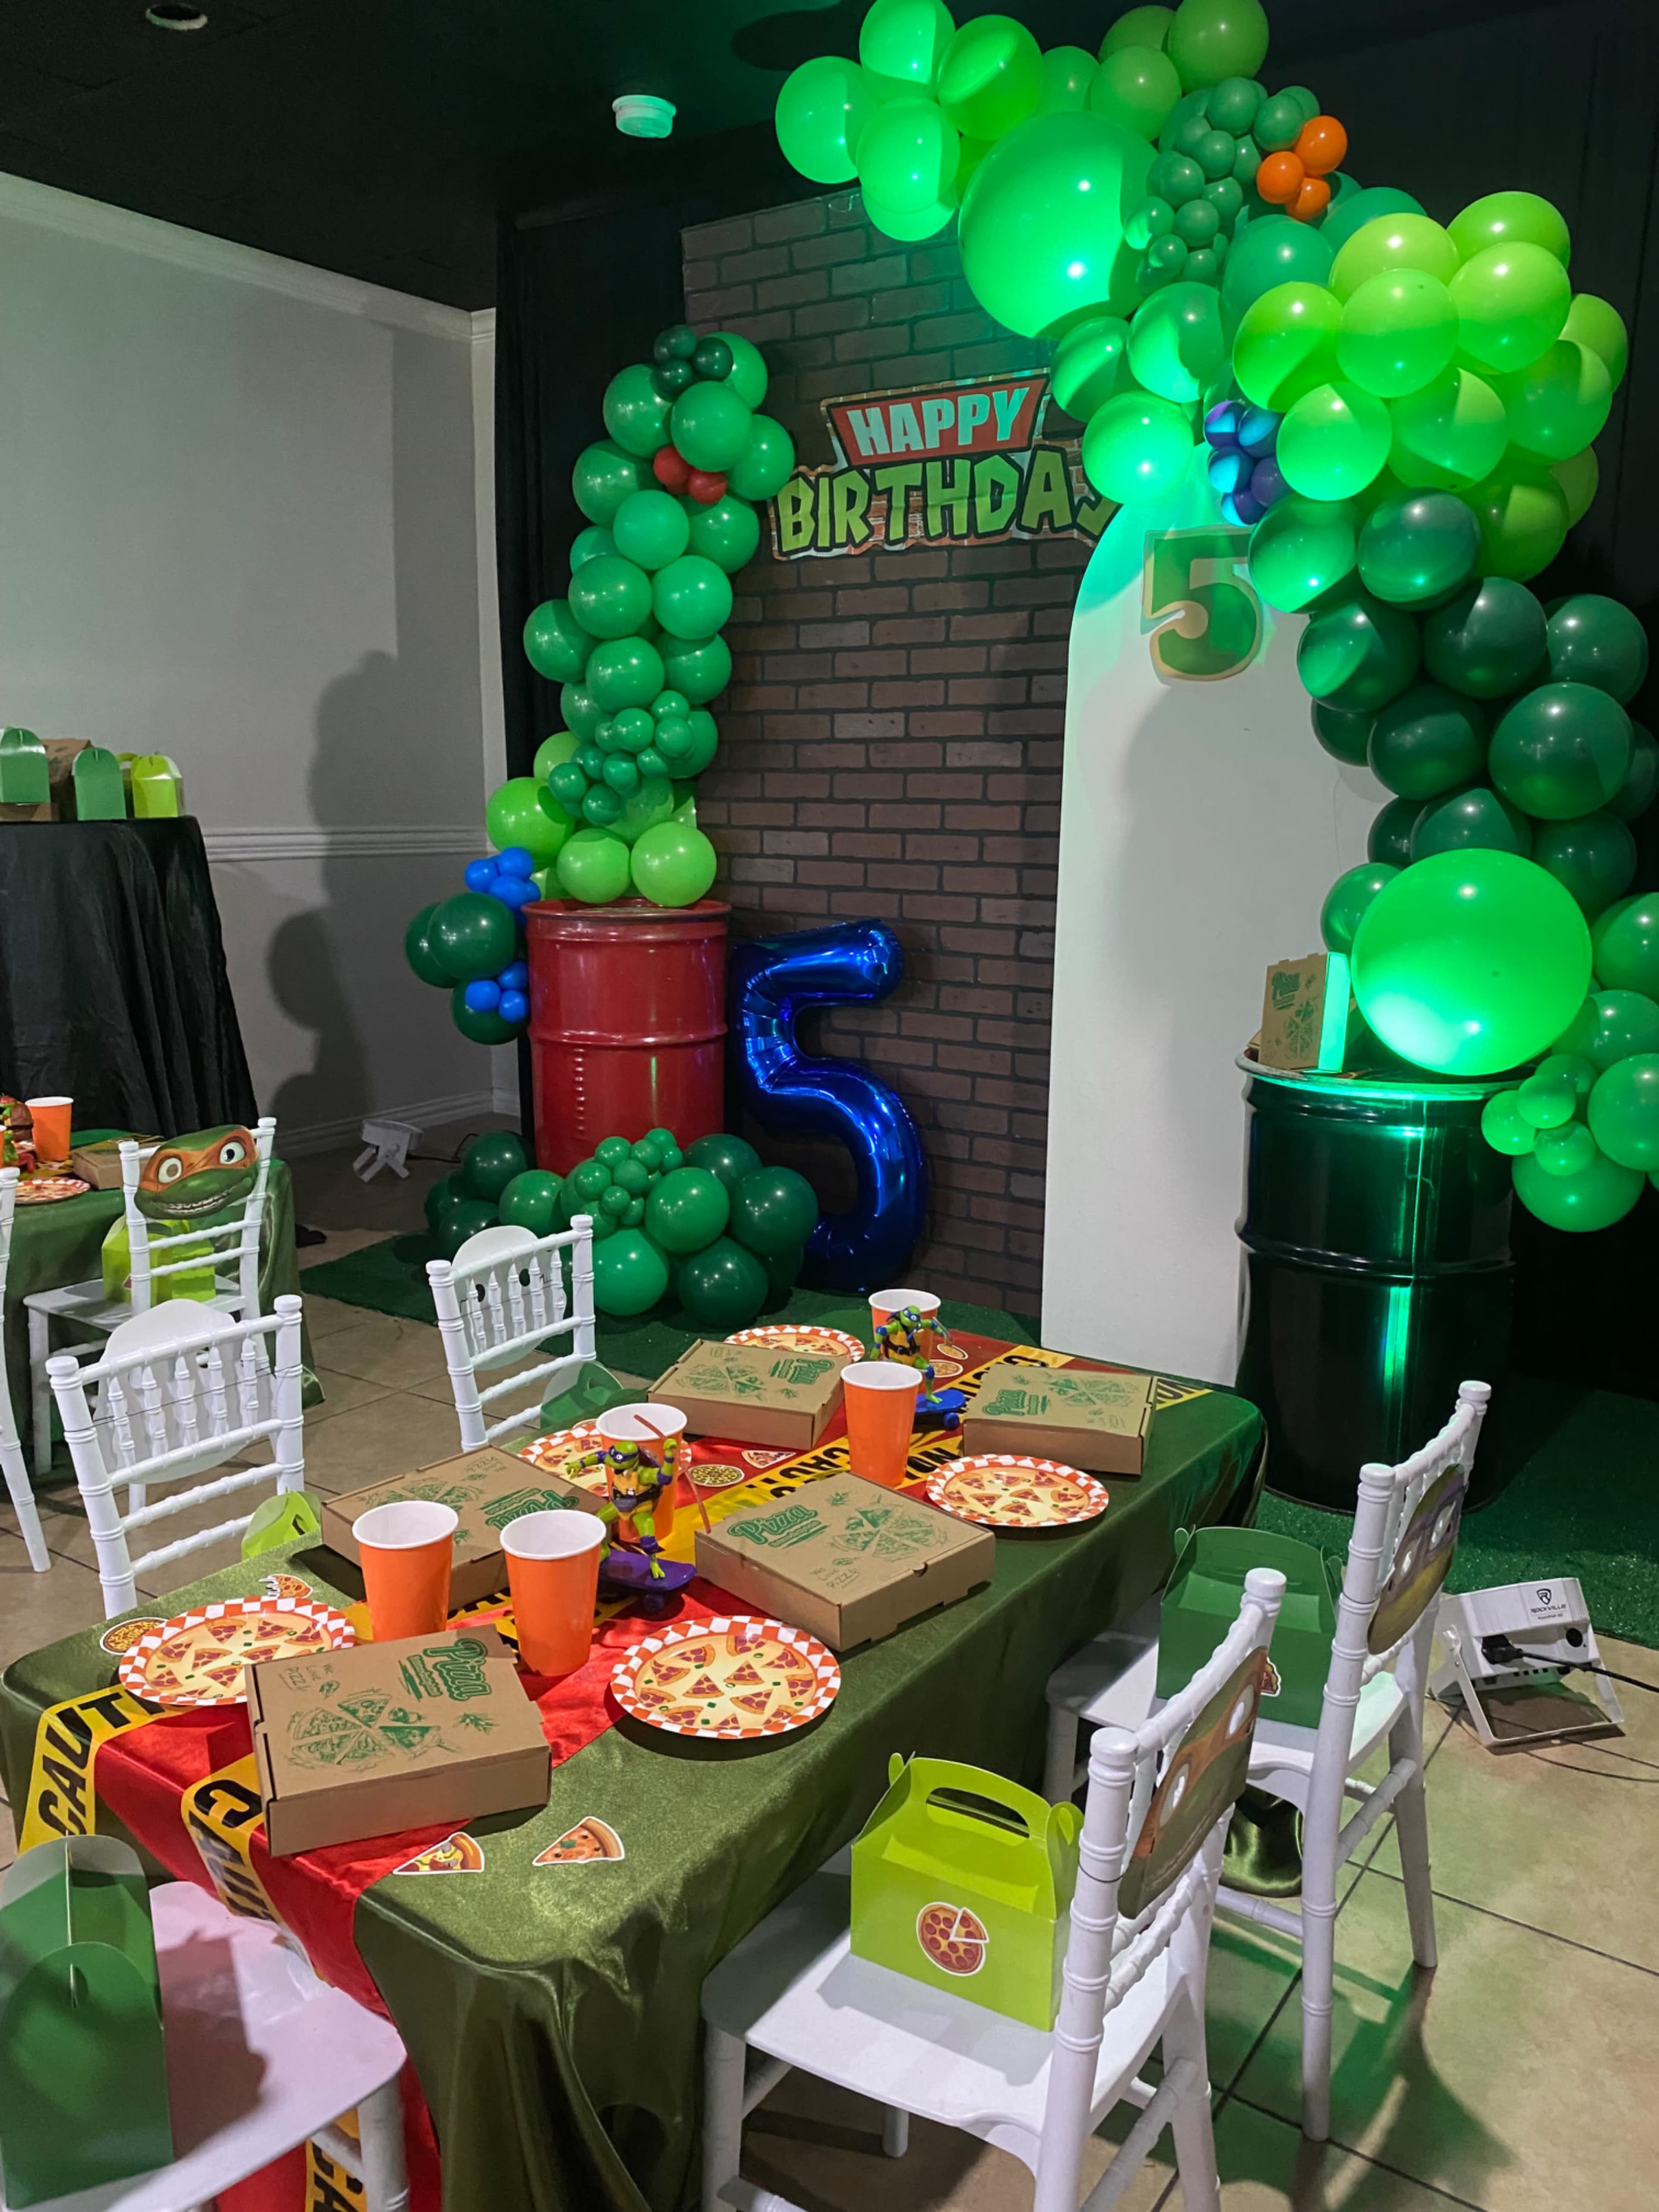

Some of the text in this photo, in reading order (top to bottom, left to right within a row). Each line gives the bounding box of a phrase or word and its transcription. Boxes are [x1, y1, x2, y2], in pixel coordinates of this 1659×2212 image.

[846, 386, 1030, 457] HAPPY
[1145, 527, 1260, 681] 5
[727, 1504, 818, 1545] Pizza
[1530, 1604, 1567, 1613] ROCKVILLE
[422, 1637, 493, 1701] Pizza
